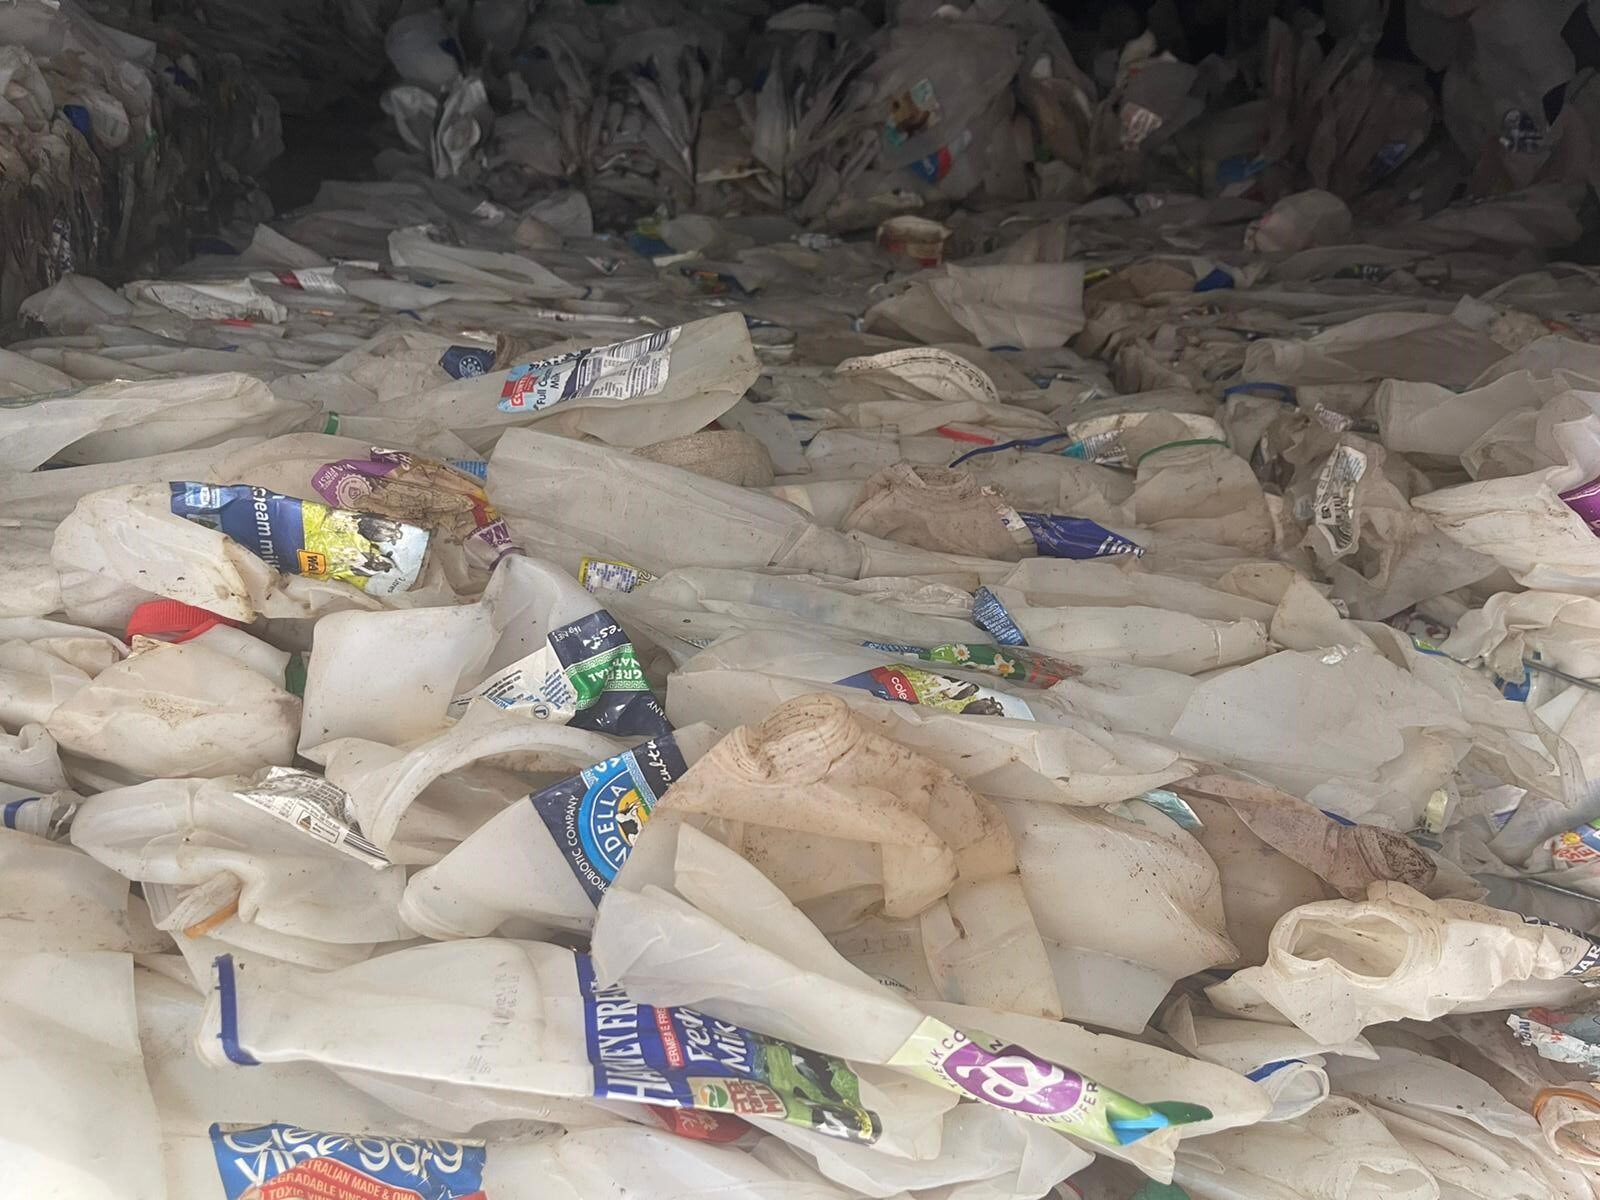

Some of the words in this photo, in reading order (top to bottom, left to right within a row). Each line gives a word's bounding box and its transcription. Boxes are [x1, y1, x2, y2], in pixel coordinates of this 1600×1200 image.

[565, 795, 580, 846] COMPANY
[674, 1007, 711, 1061] Freh
[713, 1020, 751, 1073] Mik
[351, 1176, 381, 1198] MADE
[383, 1189, 390, 1200] &
